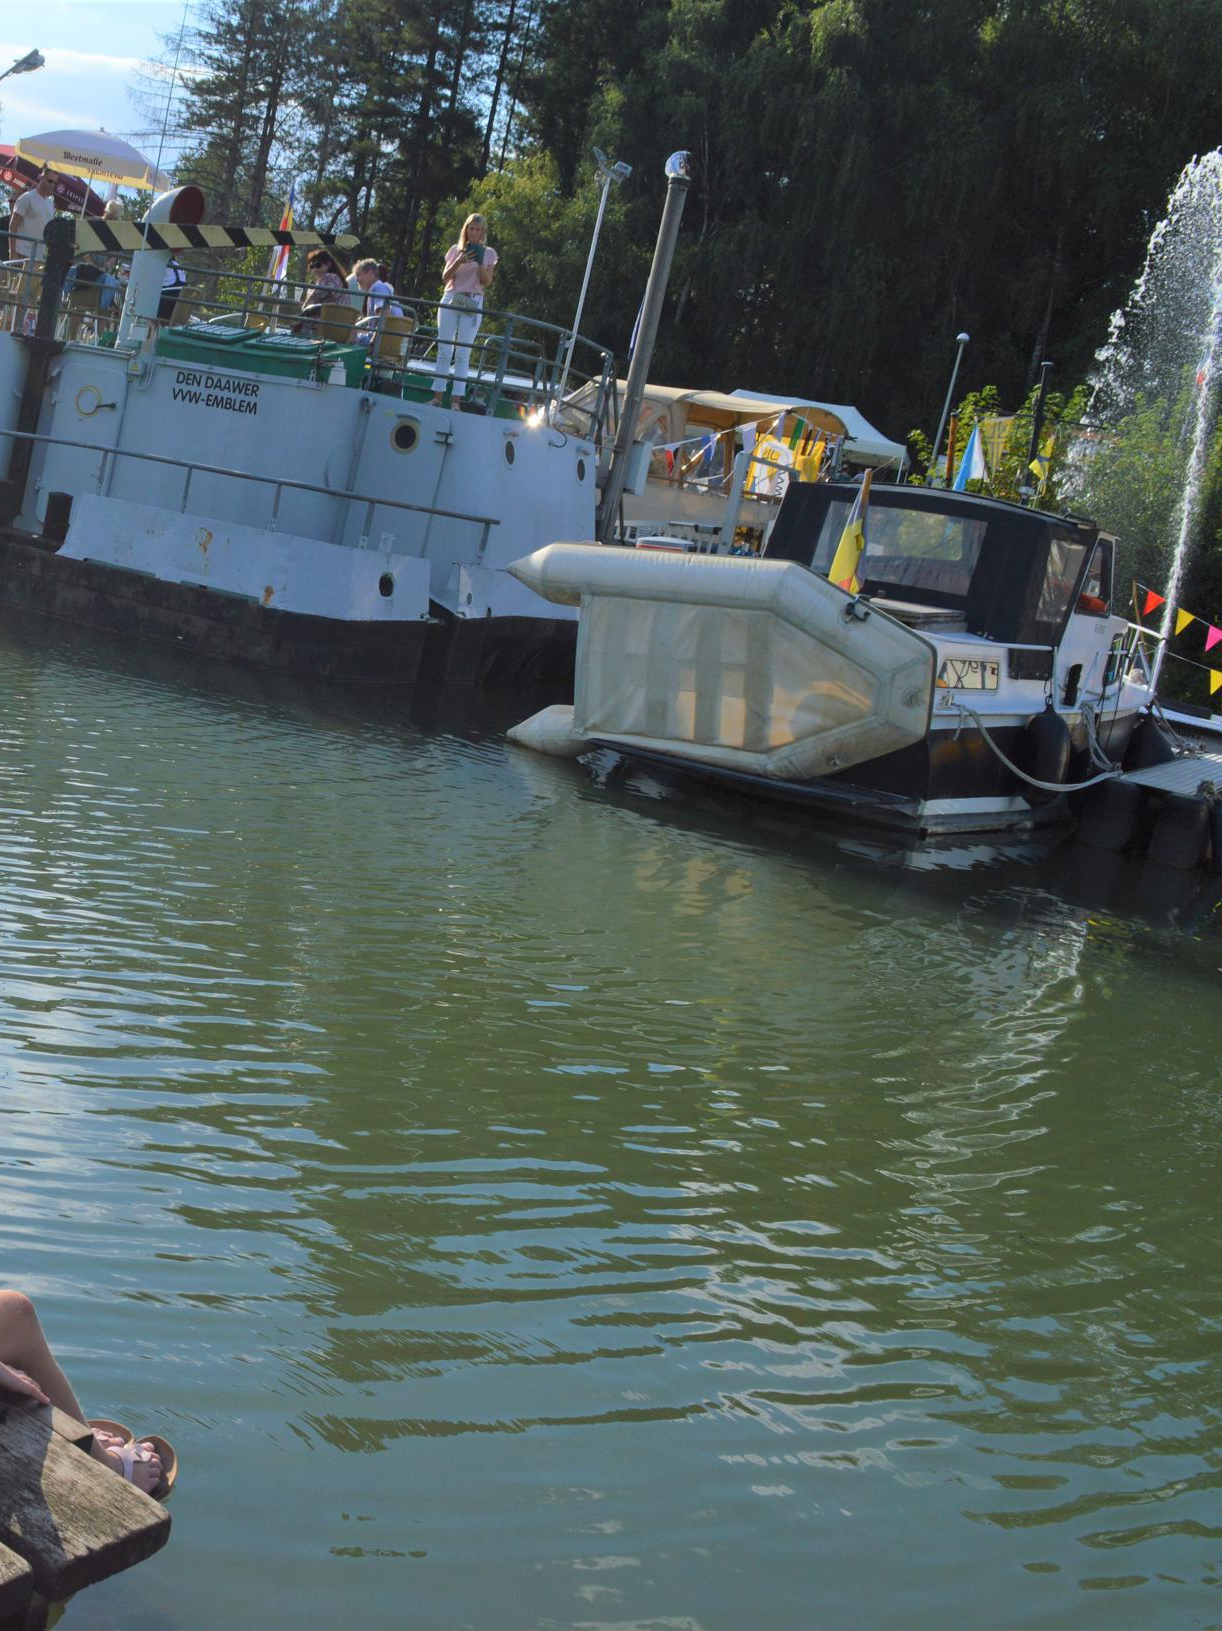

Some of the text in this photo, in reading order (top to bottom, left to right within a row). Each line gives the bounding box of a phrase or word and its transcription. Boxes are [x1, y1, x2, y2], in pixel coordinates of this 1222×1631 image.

[63, 151, 103, 167] Westmalle
[176, 371, 260, 398] DEN DAAWER
[172, 387, 258, 416] VVW-EMBLEM
